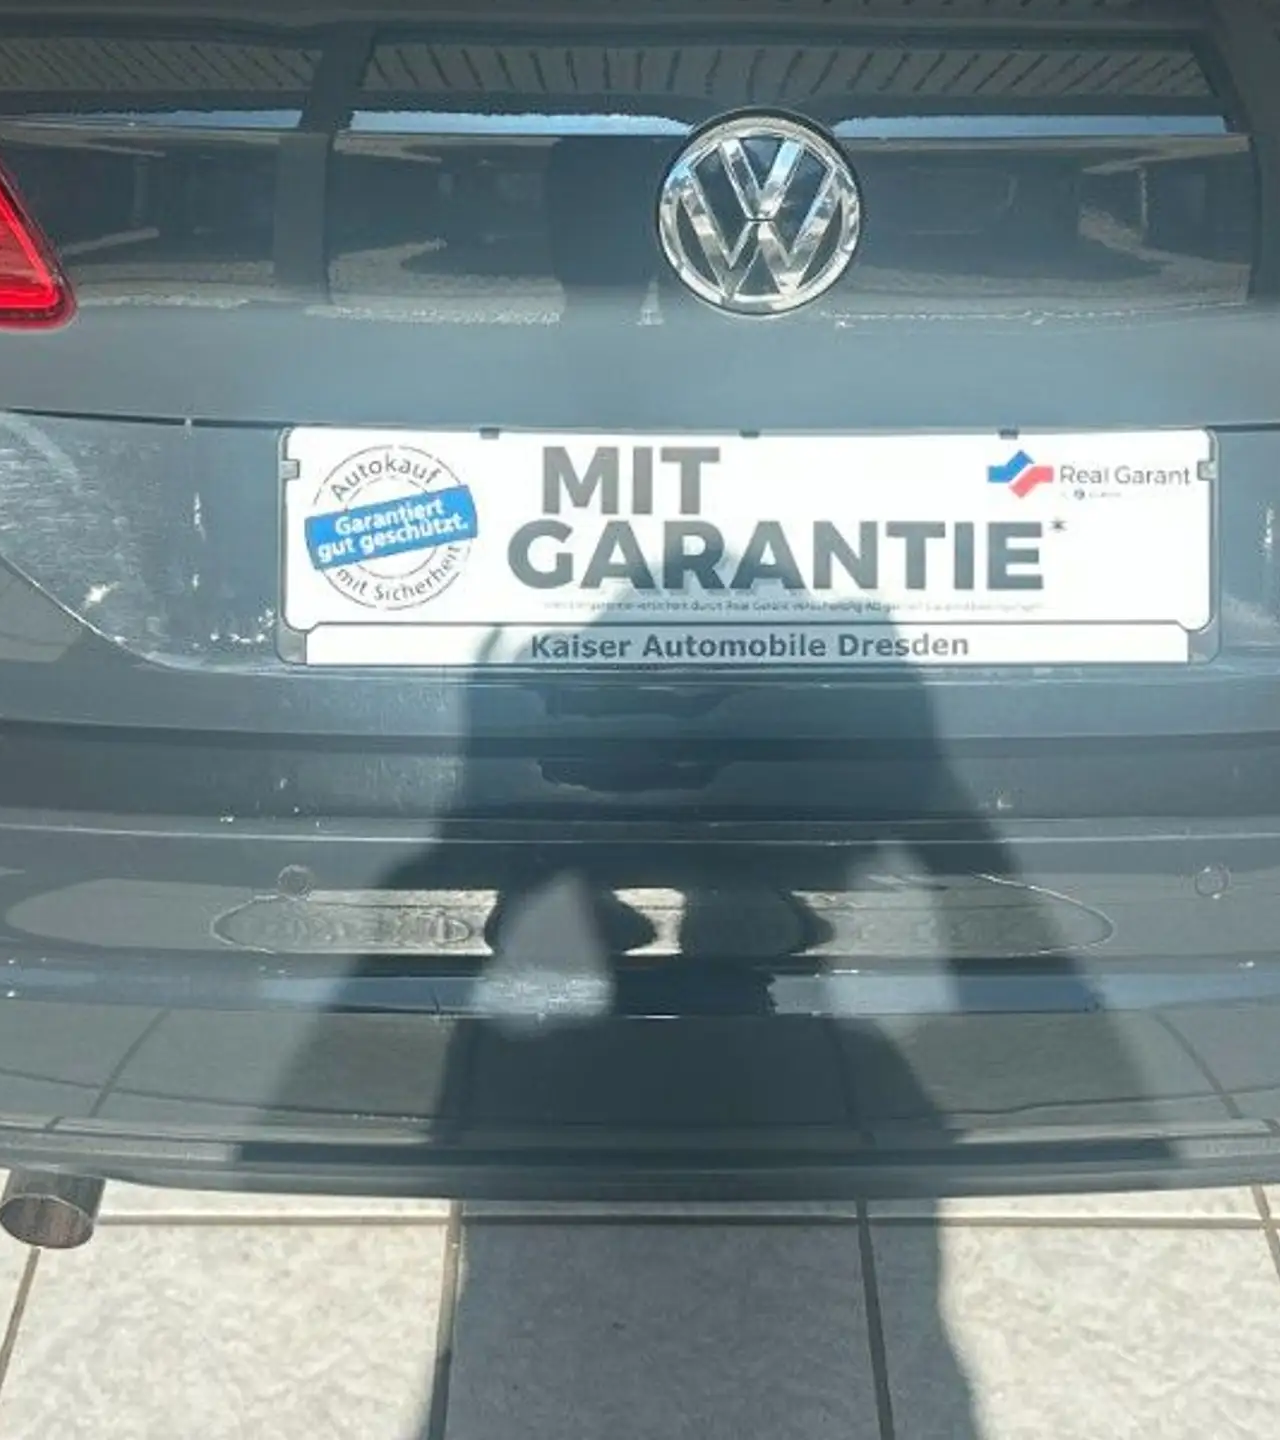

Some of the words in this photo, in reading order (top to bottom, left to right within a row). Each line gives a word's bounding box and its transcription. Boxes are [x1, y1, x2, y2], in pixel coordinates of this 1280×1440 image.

[670, 134, 844, 304] VW
[331, 451, 443, 502] Autokauf
[541, 445, 721, 516] MIT
[1059, 464, 1109, 485] Real
[1114, 464, 1192, 486] Garant
[334, 497, 445, 536] Garantiert
[317, 536, 355, 563] gut
[335, 567, 369, 597] mit
[374, 544, 461, 602] Sicherheit
[530, 633, 631, 659] Kaiser
[642, 632, 827, 658] Automobile
[837, 632, 970, 657] Dresden
